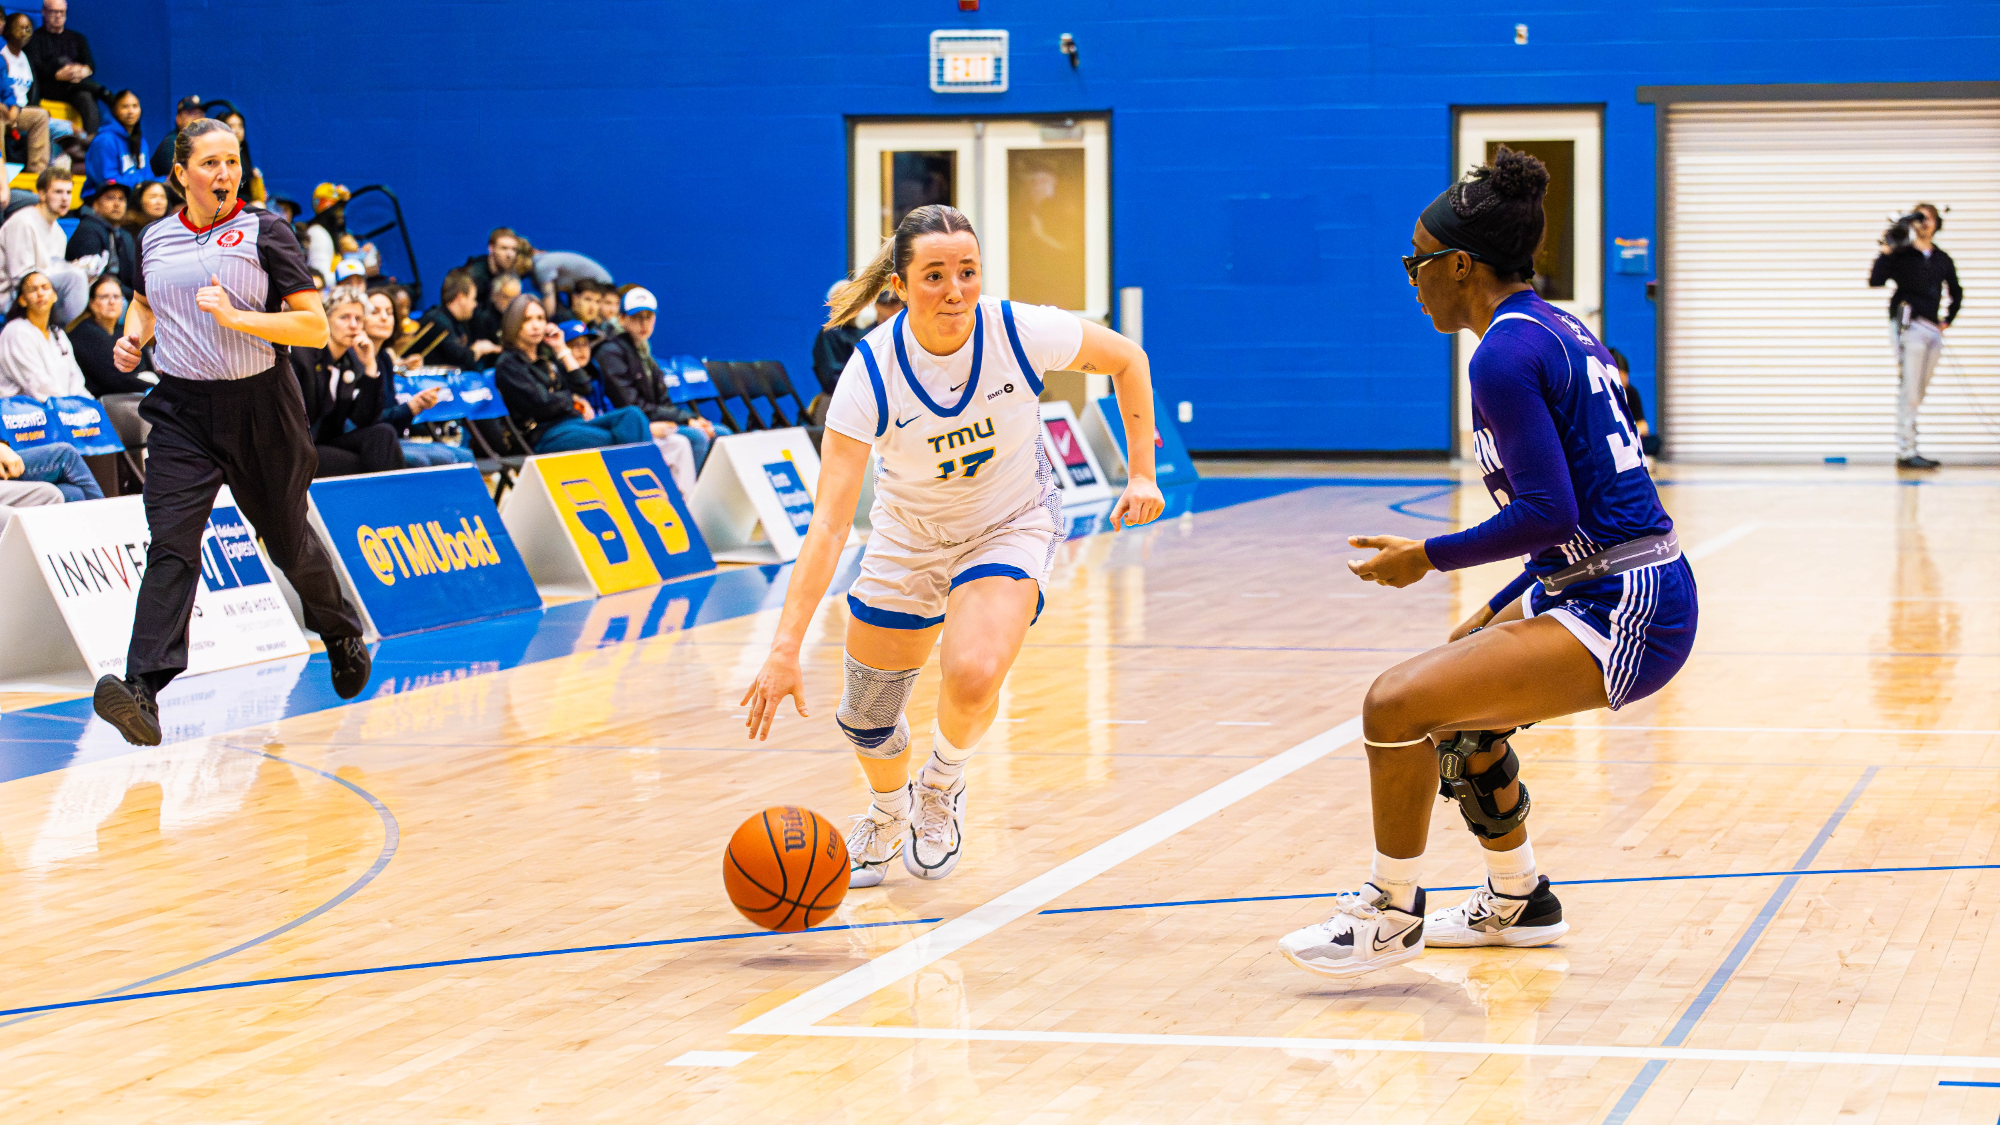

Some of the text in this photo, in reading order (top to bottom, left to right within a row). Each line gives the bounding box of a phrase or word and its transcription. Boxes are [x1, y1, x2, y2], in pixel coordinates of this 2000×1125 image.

[986, 389, 1004, 401] BMO
[927, 416, 995, 454] TMU
[934, 446, 997, 481] 17
[356, 514, 501, 586] @TMUbold
[252, 597, 280, 612] HOTEL
